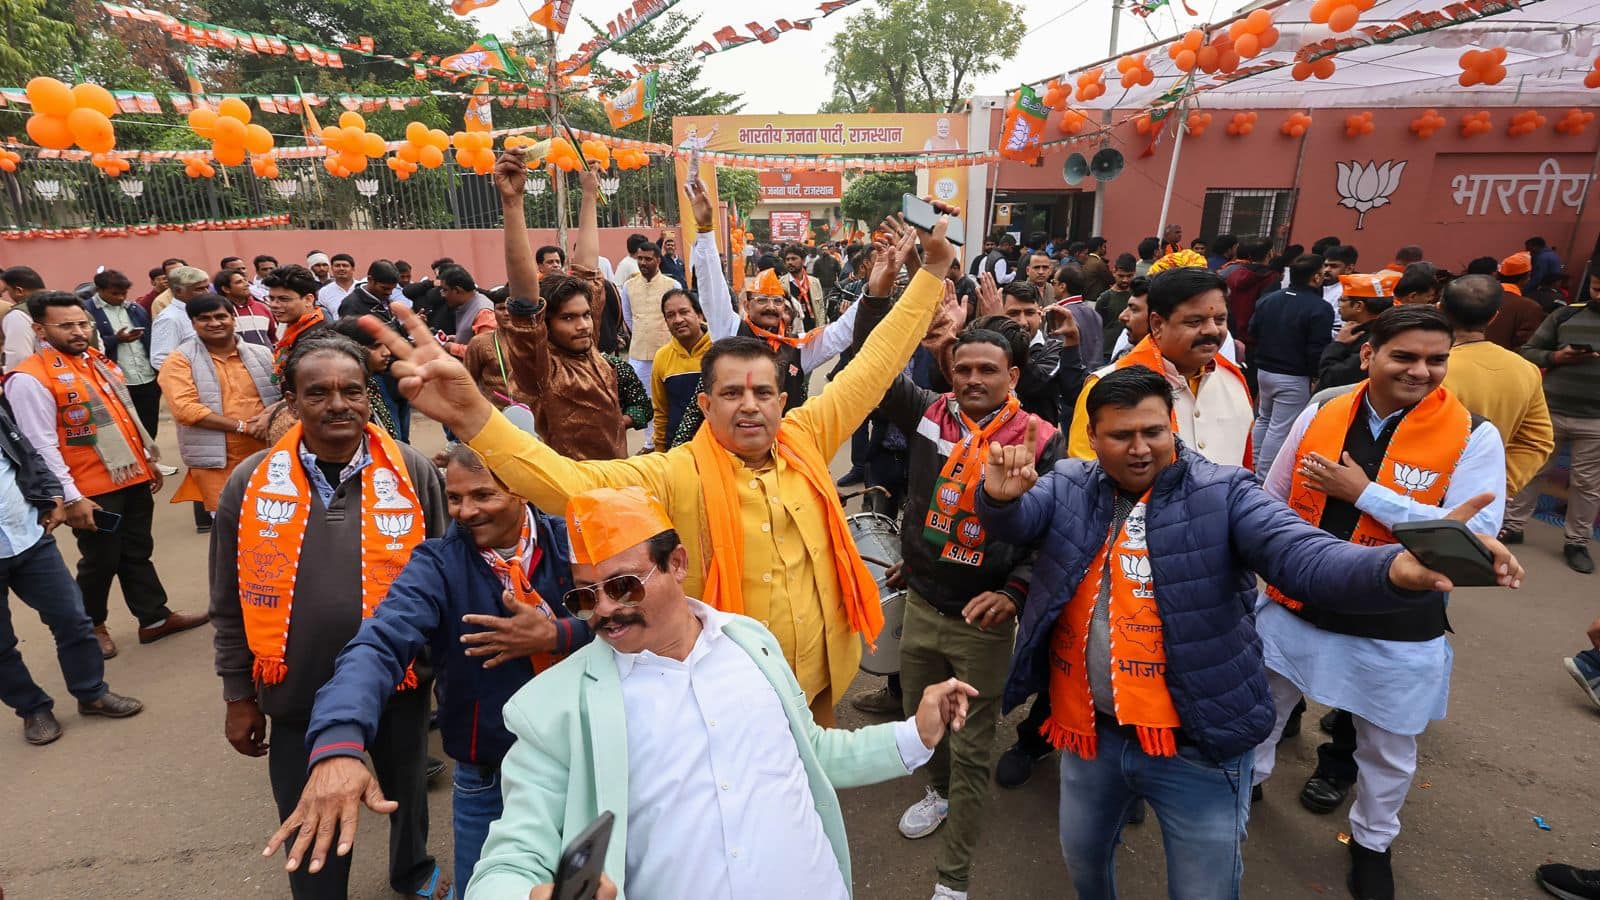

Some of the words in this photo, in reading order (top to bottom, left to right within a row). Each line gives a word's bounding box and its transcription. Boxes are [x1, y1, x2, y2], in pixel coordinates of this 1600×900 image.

[738, 123, 783, 144] भारतीय
[783, 128, 818, 143] जनता
[819, 122, 846, 146] पार्टी,
[847, 127, 904, 143] राजस्थान
[1451, 157, 1591, 216] भारतीय
